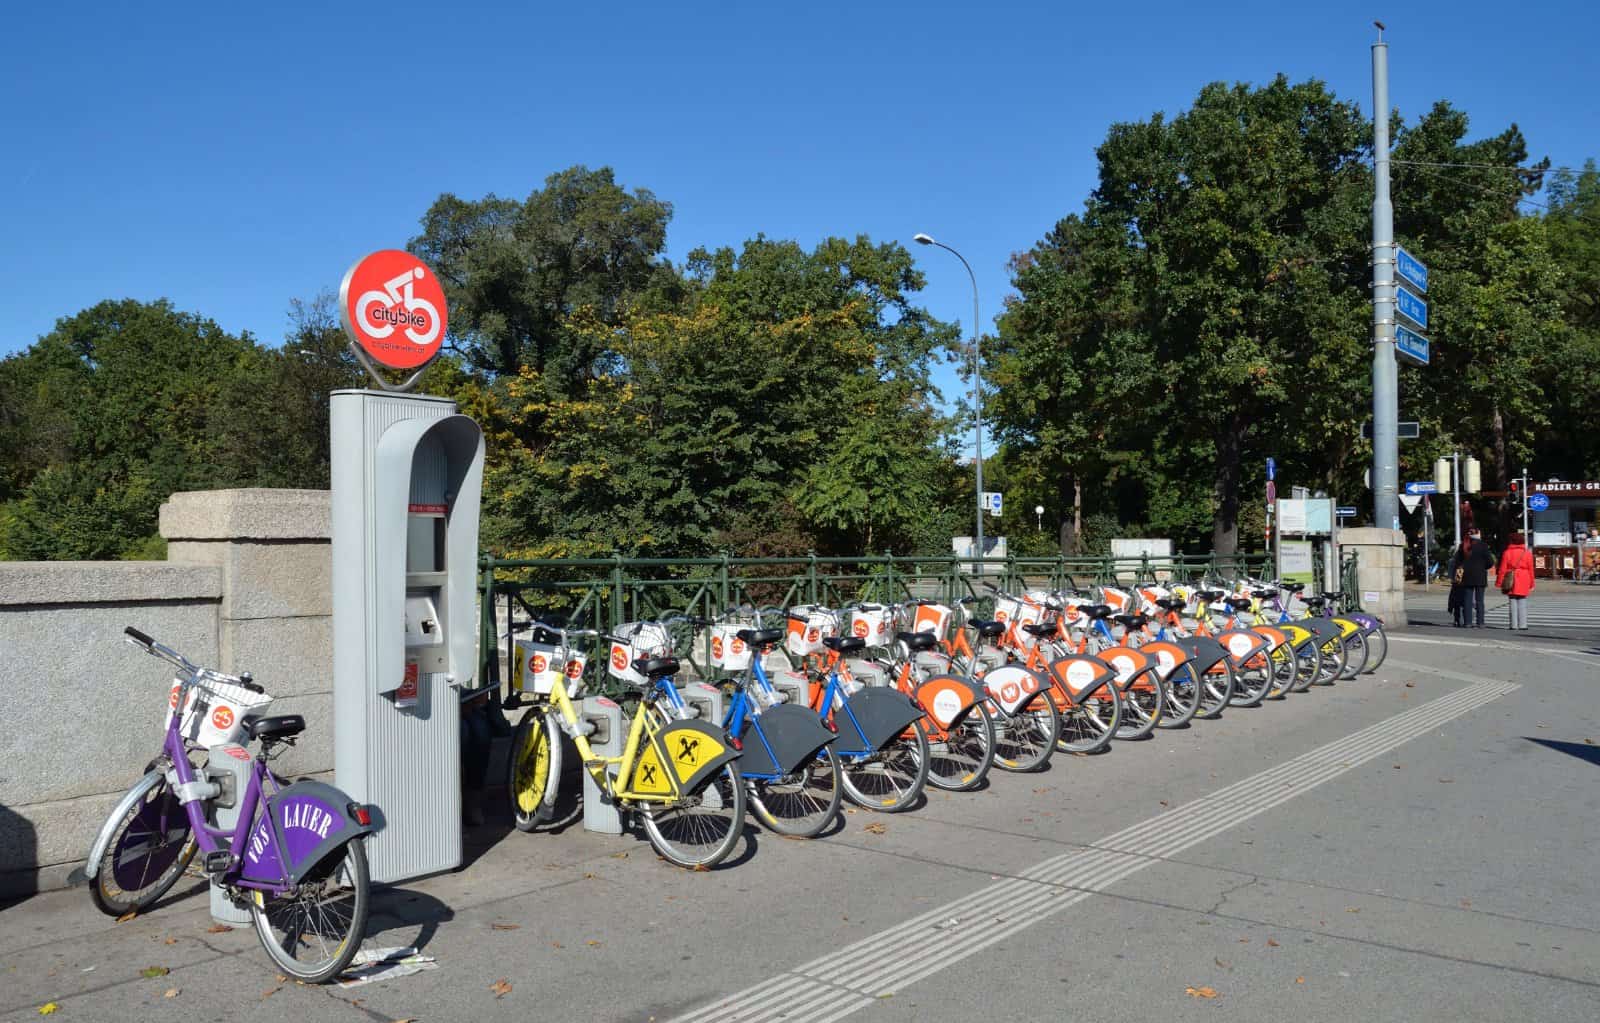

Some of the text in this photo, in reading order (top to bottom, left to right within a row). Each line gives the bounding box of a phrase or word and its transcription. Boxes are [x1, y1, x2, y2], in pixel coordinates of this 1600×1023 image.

[372, 307, 425, 327] citybike
[248, 803, 332, 864] VÖS LAUER
